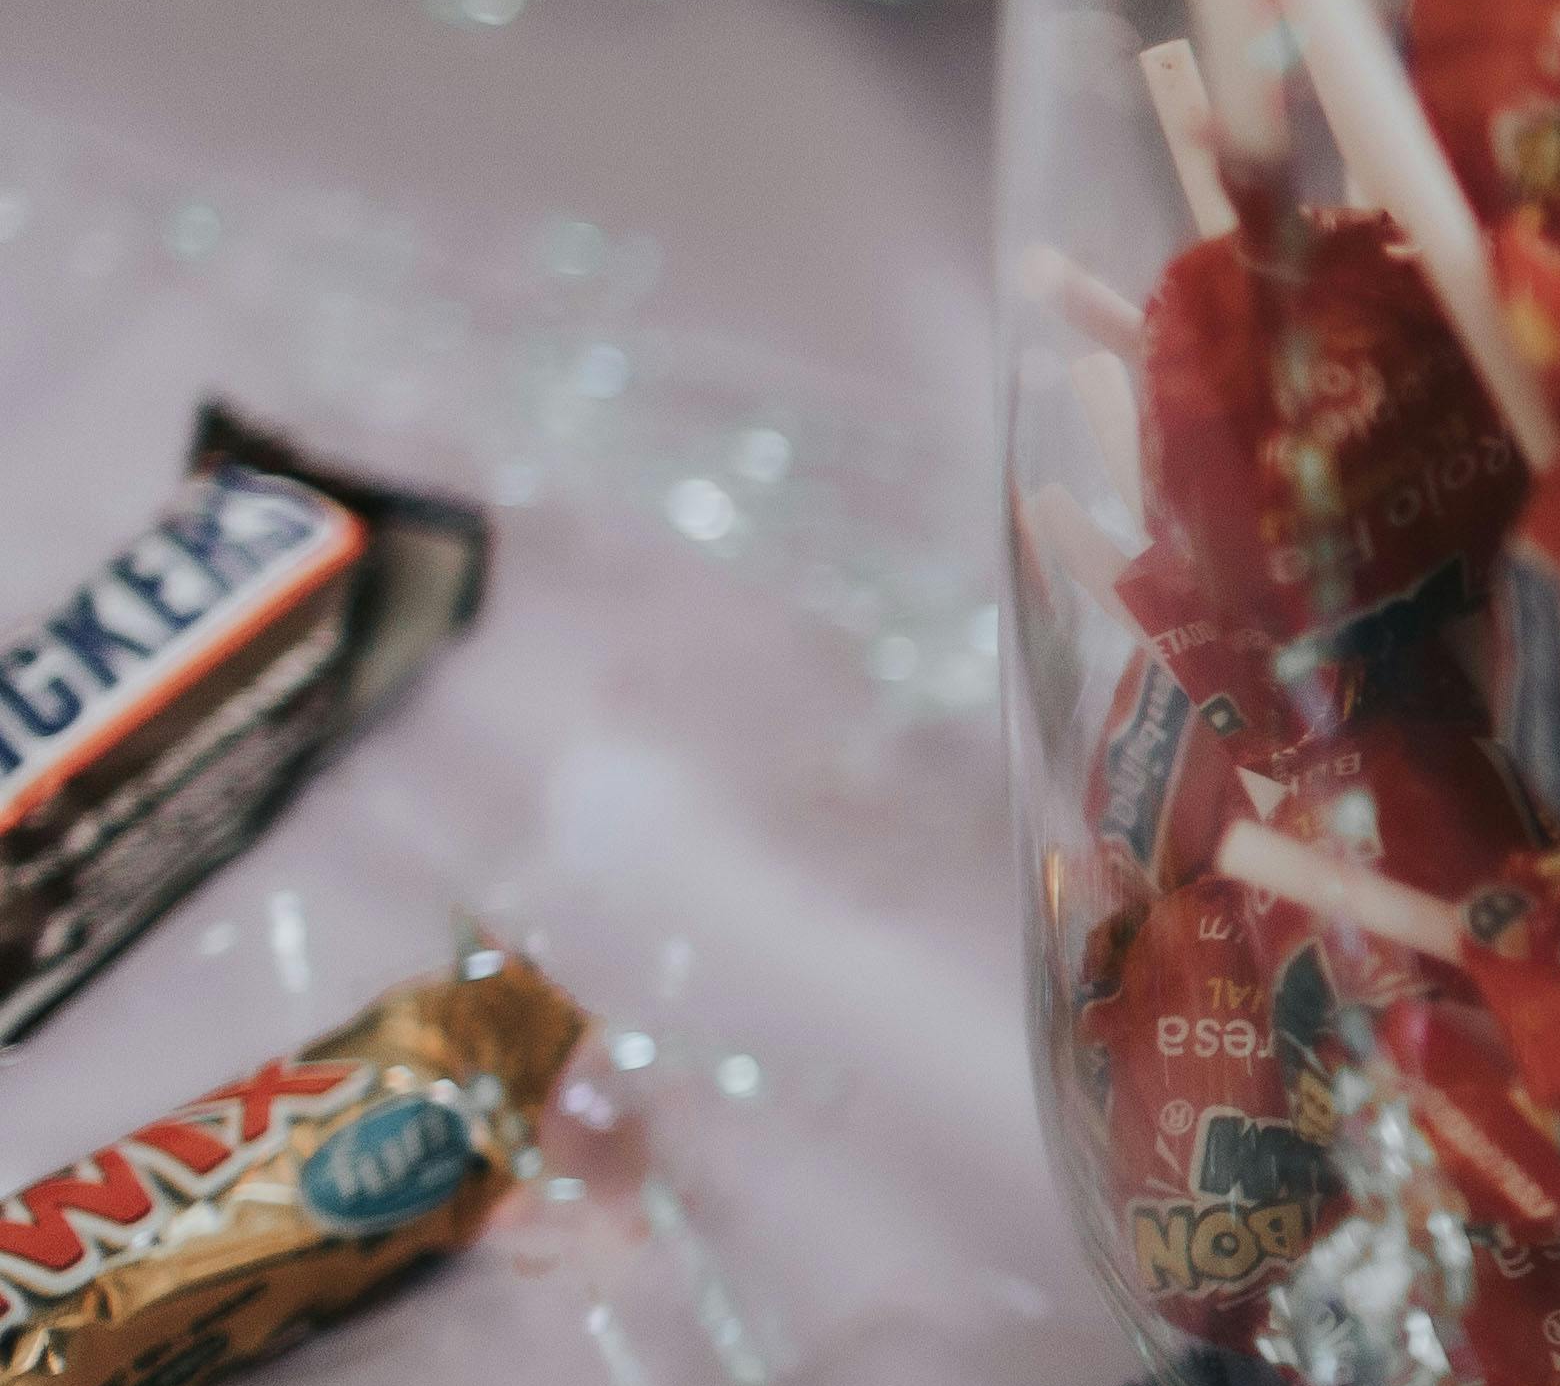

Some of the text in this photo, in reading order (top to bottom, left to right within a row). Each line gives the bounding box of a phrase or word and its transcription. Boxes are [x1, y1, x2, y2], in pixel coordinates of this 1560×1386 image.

[1155, 1014, 1272, 1069] resa
[0, 1056, 378, 1308] WIX
[1131, 1201, 1305, 1294] BON
